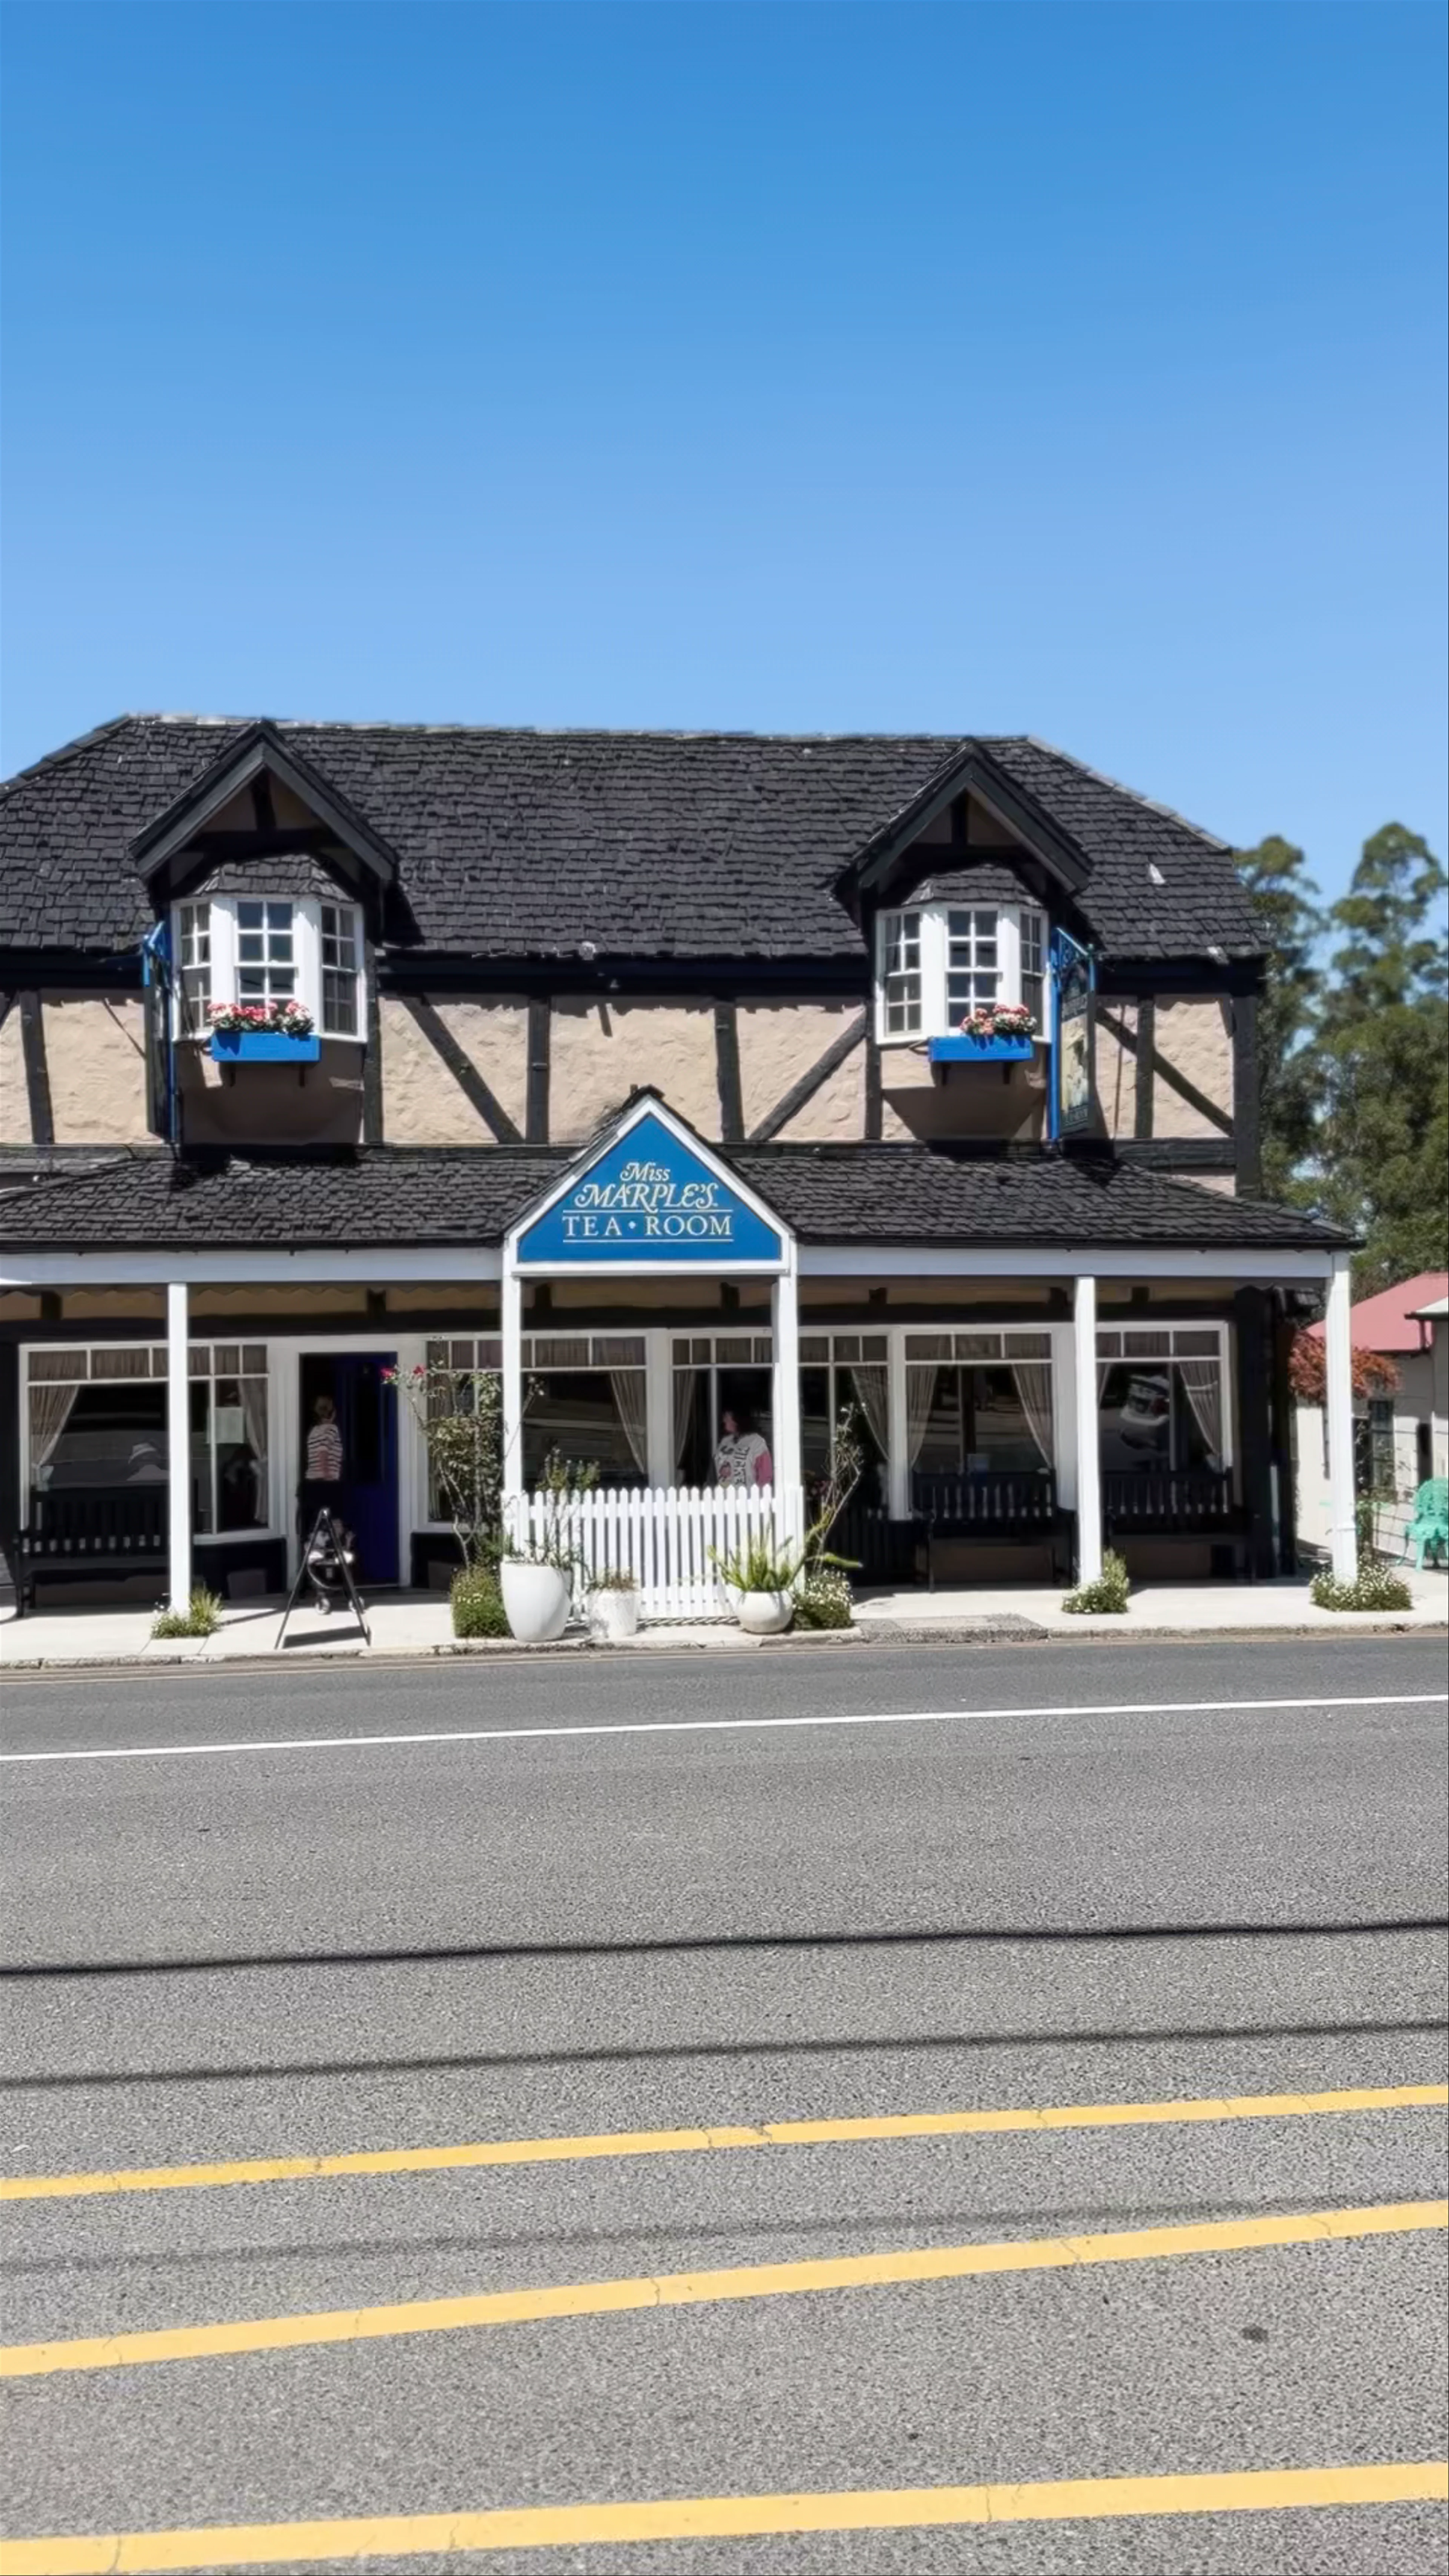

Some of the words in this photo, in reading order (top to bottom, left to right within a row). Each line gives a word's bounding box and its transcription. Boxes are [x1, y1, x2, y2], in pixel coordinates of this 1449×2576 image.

[620, 1162, 671, 1182] Miss
[574, 1182, 718, 1213] MARPLE'S
[563, 1215, 622, 1236] TEA
[645, 1215, 732, 1236] ROOM
